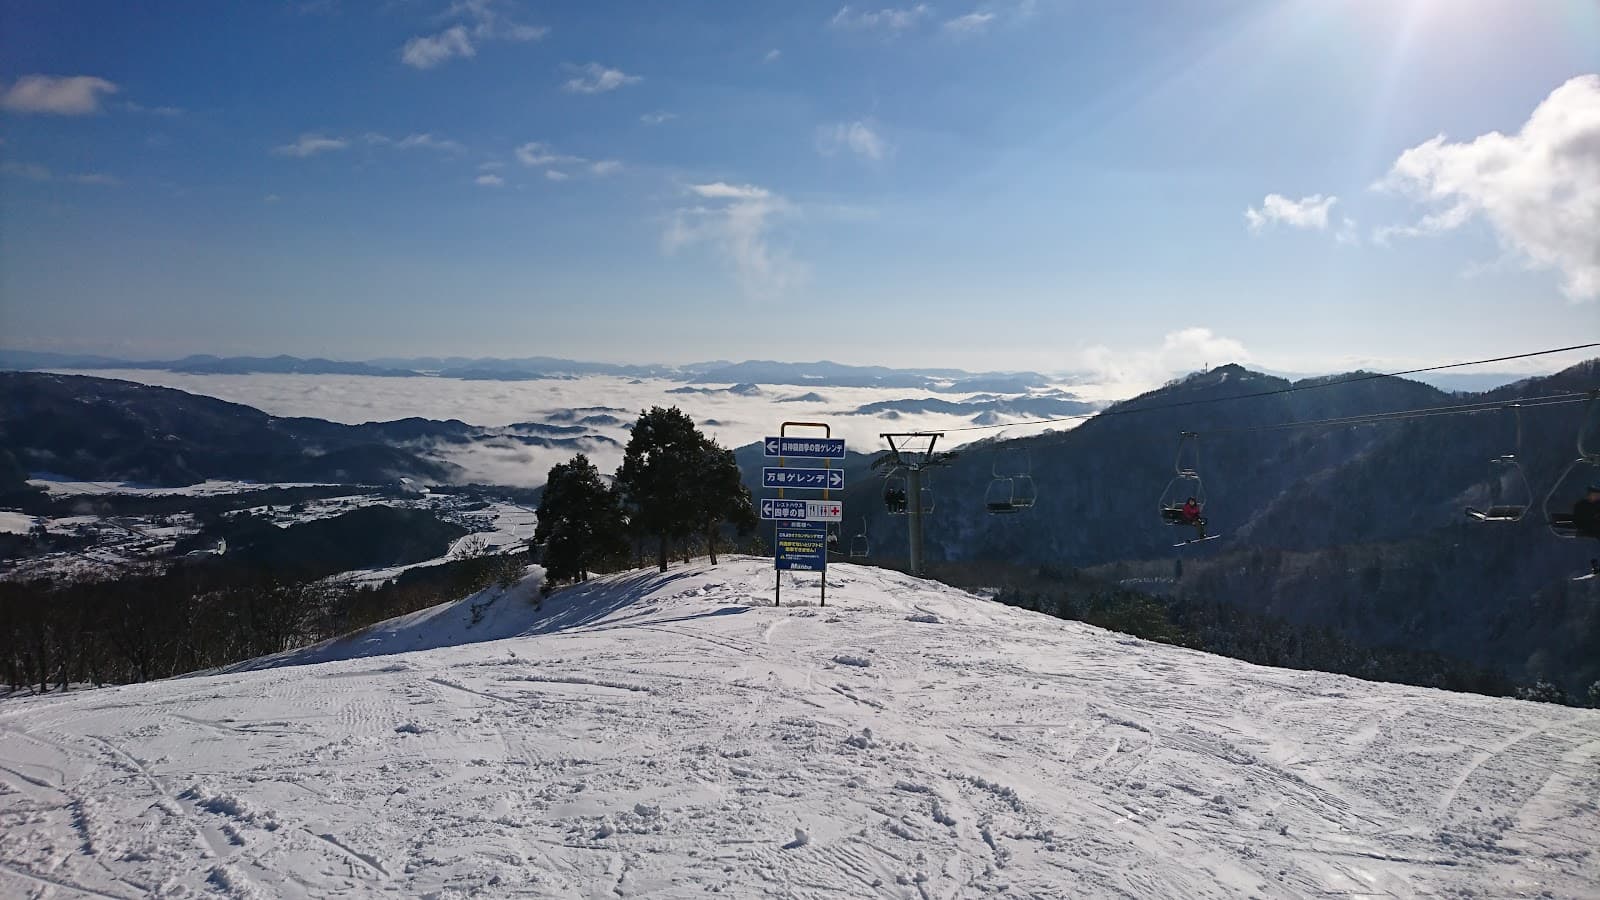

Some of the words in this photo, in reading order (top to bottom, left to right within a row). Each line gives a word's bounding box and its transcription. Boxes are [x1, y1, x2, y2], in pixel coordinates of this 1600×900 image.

[767, 472, 825, 483] 万場ゲレンデ
